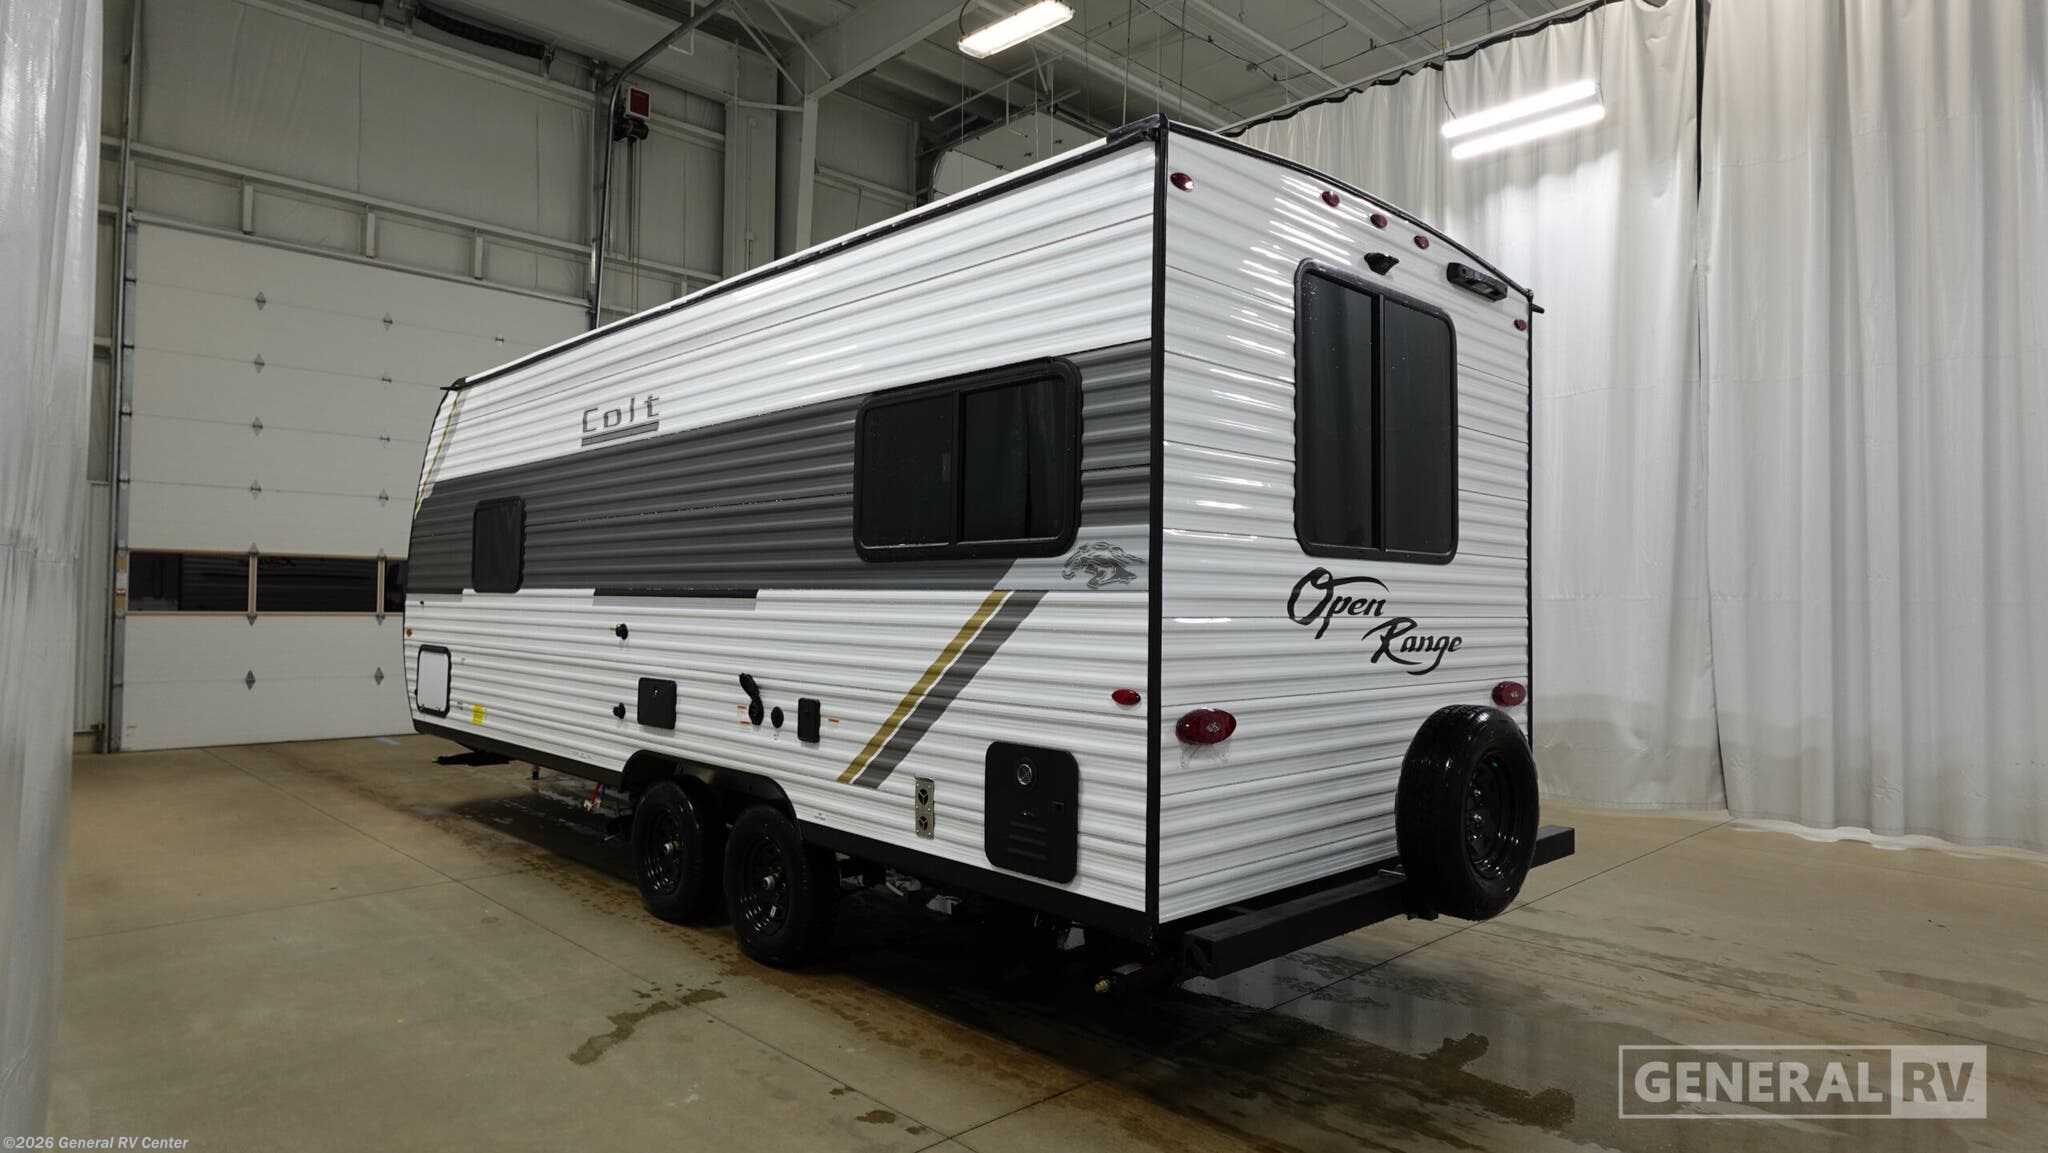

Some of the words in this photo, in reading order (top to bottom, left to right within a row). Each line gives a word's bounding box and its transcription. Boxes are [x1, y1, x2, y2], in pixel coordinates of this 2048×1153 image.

[582, 393, 660, 433] Colt
[1287, 566, 1390, 639] Open
[1361, 617, 1463, 675] Range
